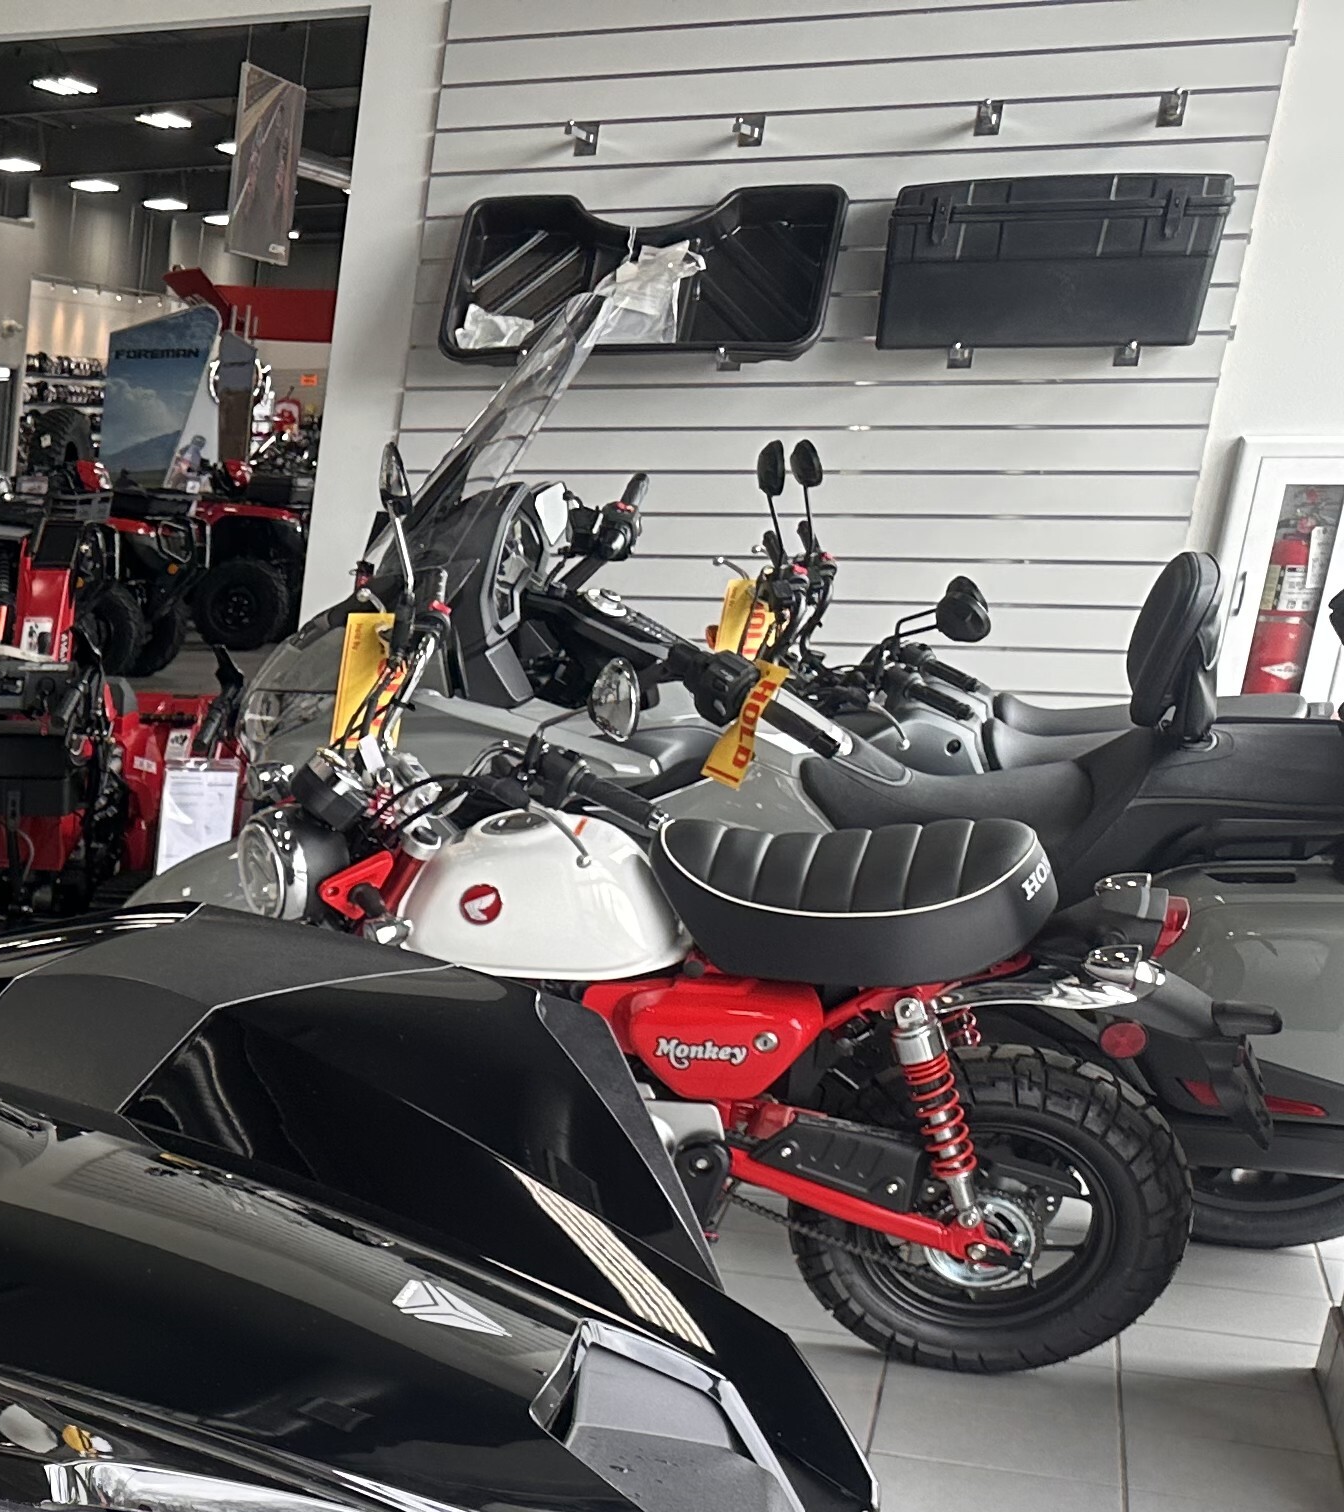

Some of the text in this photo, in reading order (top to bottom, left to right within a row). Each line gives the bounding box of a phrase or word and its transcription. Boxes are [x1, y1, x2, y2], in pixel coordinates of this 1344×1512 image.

[114, 348, 200, 360] FOREMAN
[732, 679, 778, 769] HOLD
[654, 1036, 748, 1070] Monkey
